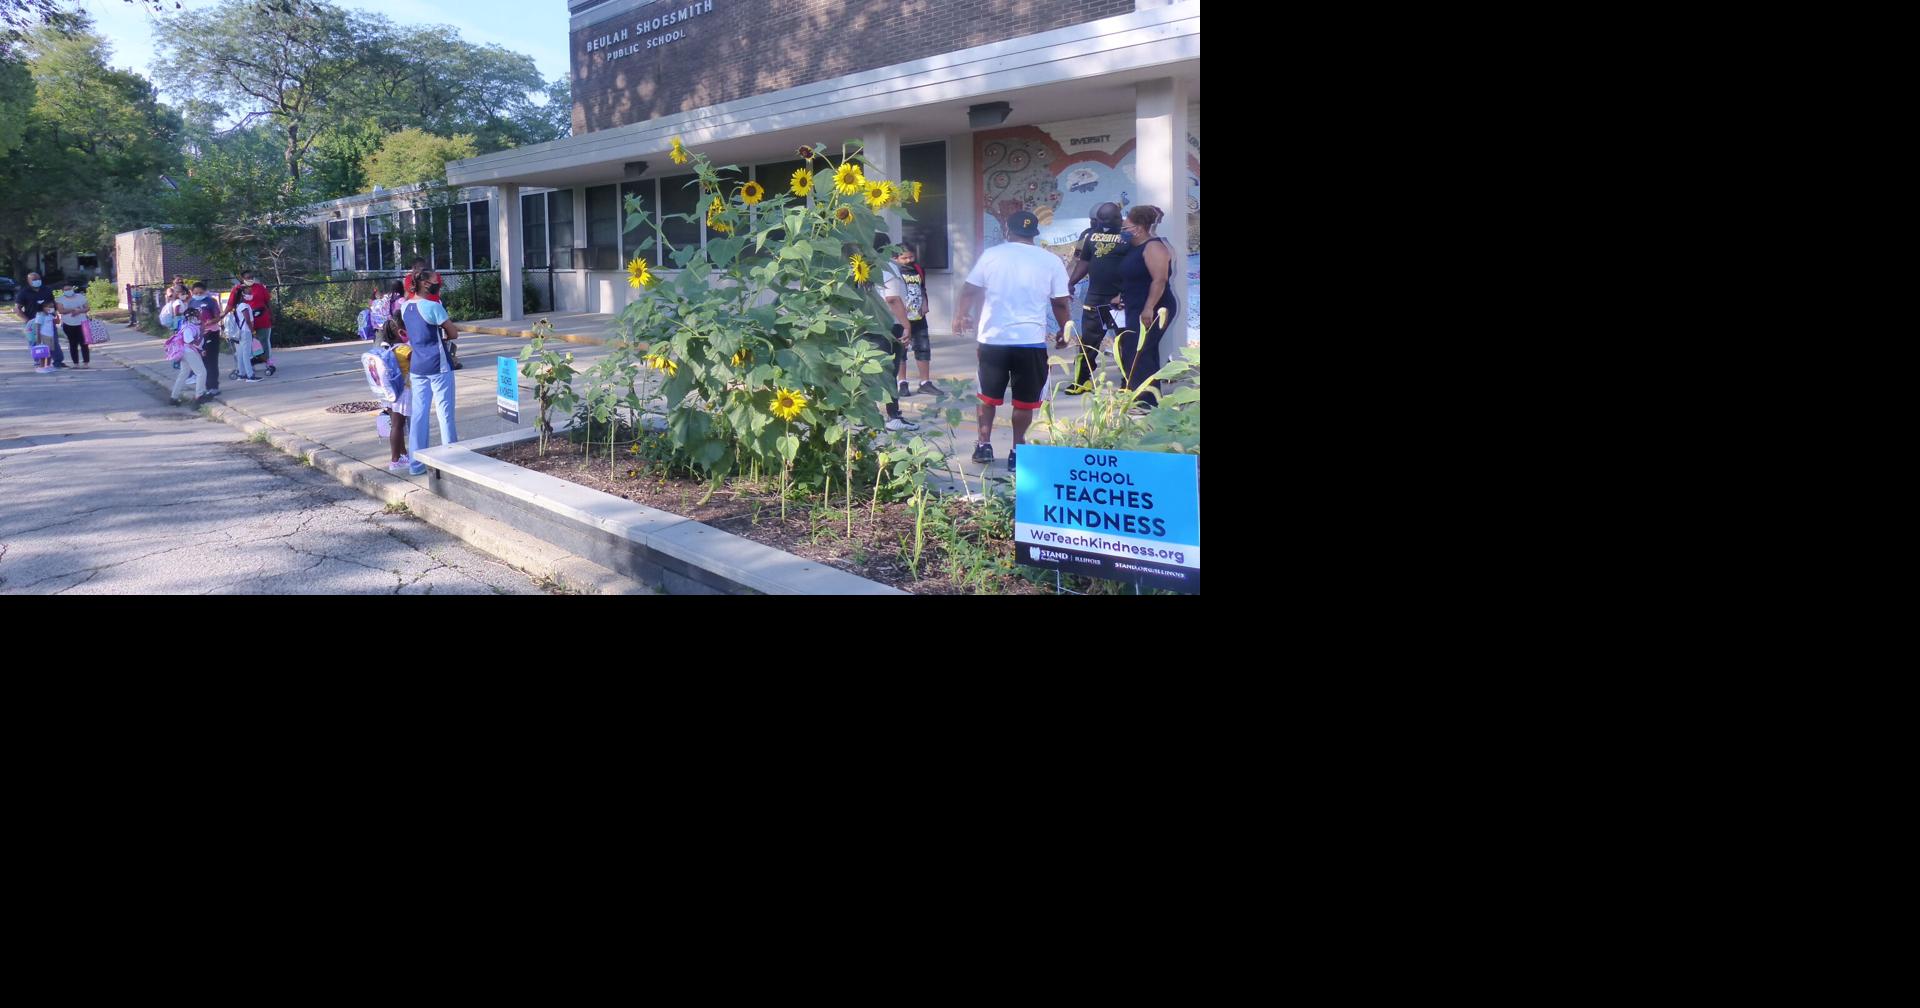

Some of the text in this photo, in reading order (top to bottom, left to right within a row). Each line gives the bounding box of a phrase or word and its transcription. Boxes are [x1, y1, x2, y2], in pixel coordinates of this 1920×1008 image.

[586, 0, 713, 52] BEULAH SHOESMITH
[607, 29, 686, 61] PUBLIC SCHOOL
[1070, 134, 1111, 146] DIVERSITY
[1084, 454, 1118, 467] OUR
[1069, 469, 1134, 486] SCHOOL
[1054, 484, 1154, 510] TEACHES
[1043, 504, 1166, 537] KINDNESS
[1030, 529, 1185, 563] WeTeachKindness.org
[1041, 549, 1069, 560] STAND
